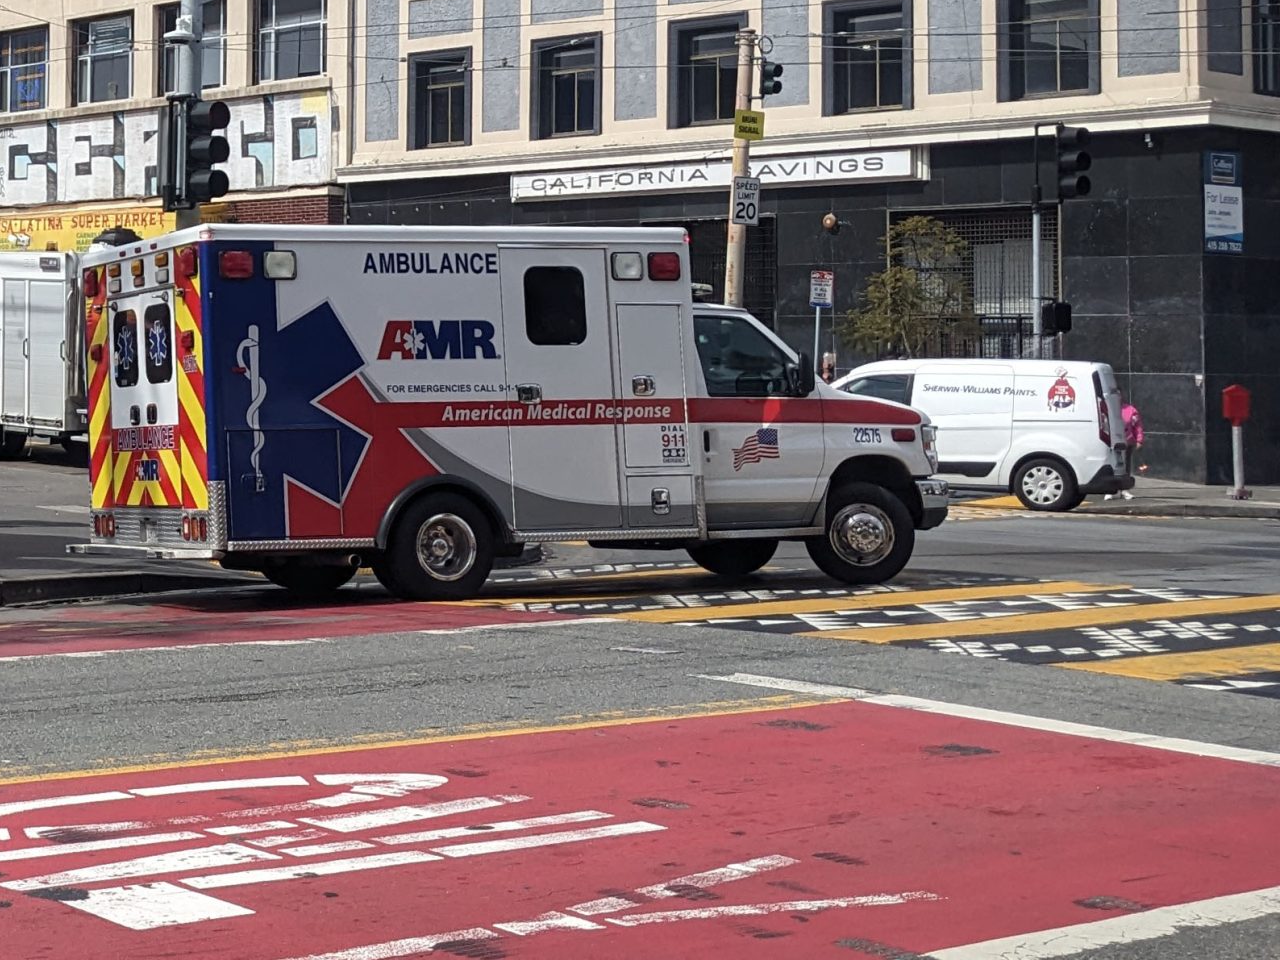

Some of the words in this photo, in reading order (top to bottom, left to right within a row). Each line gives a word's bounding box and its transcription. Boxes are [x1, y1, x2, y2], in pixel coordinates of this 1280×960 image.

[531, 168, 709, 192] CALIFORNIA
[736, 182, 758, 191] SPEED
[737, 192, 755, 200] LIMIT
[1206, 191, 1218, 203] For
[735, 202, 756, 220] 20
[19, 216, 63, 232] LATINA
[72, 214, 110, 229] SUPER
[115, 212, 165, 228] MARKET
[363, 252, 498, 274] AMBULANCE
[377, 320, 498, 360] AMR
[386, 384, 405, 393] FOR
[408, 384, 471, 393] EMERGENCIES
[474, 384, 497, 393] CALL
[442, 405, 523, 422] American
[526, 403, 591, 421] Medical
[595, 403, 671, 422] Response
[117, 425, 175, 451] AMBULANCE
[853, 427, 882, 443] 22575
[133, 459, 161, 481] AMR
